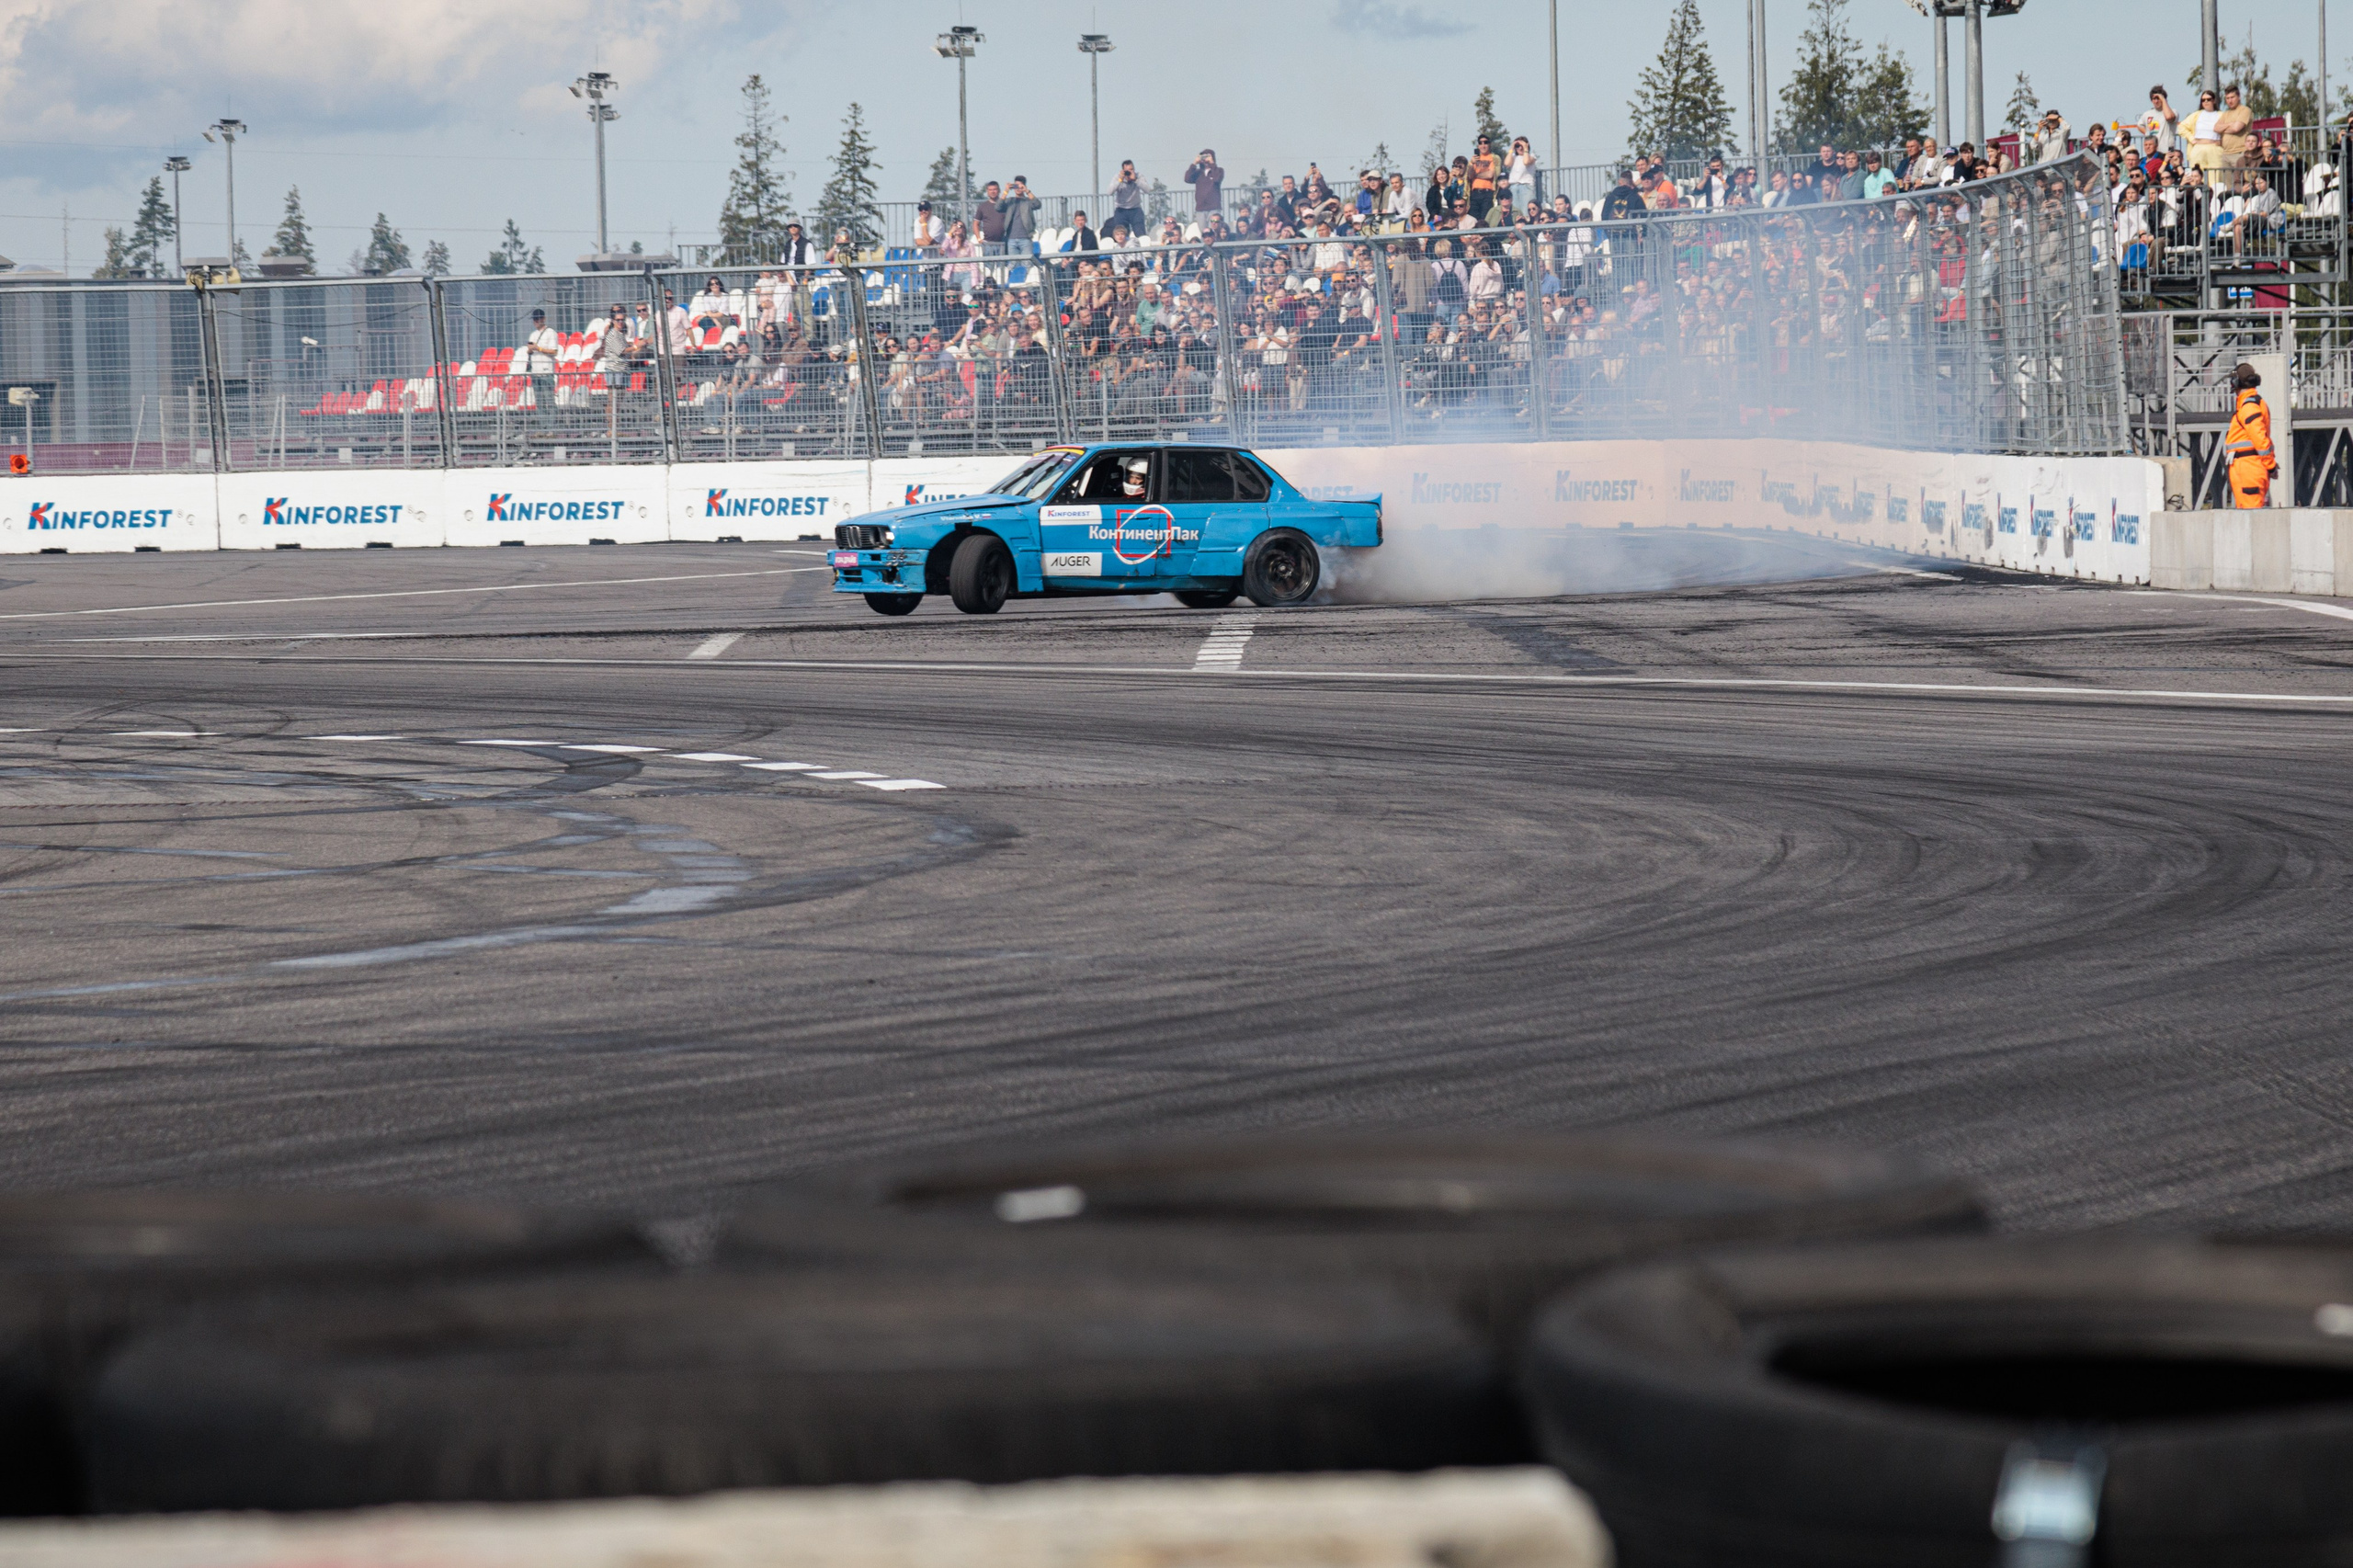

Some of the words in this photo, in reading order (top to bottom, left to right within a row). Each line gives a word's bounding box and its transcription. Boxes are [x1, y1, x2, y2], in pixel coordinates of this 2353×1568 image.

[1411, 472, 1501, 504] KINFOREST
[1555, 470, 1636, 502] KINFOREST
[28, 502, 173, 530] KINFOREST
[263, 497, 403, 526] KINFOREST
[487, 494, 625, 521] KINFOREST
[706, 489, 829, 517] KINFOREST
[1047, 509, 1091, 517] KINFOREST
[1088, 525, 1199, 540] КонтинентПак
[1051, 555, 1091, 567] AUGER
